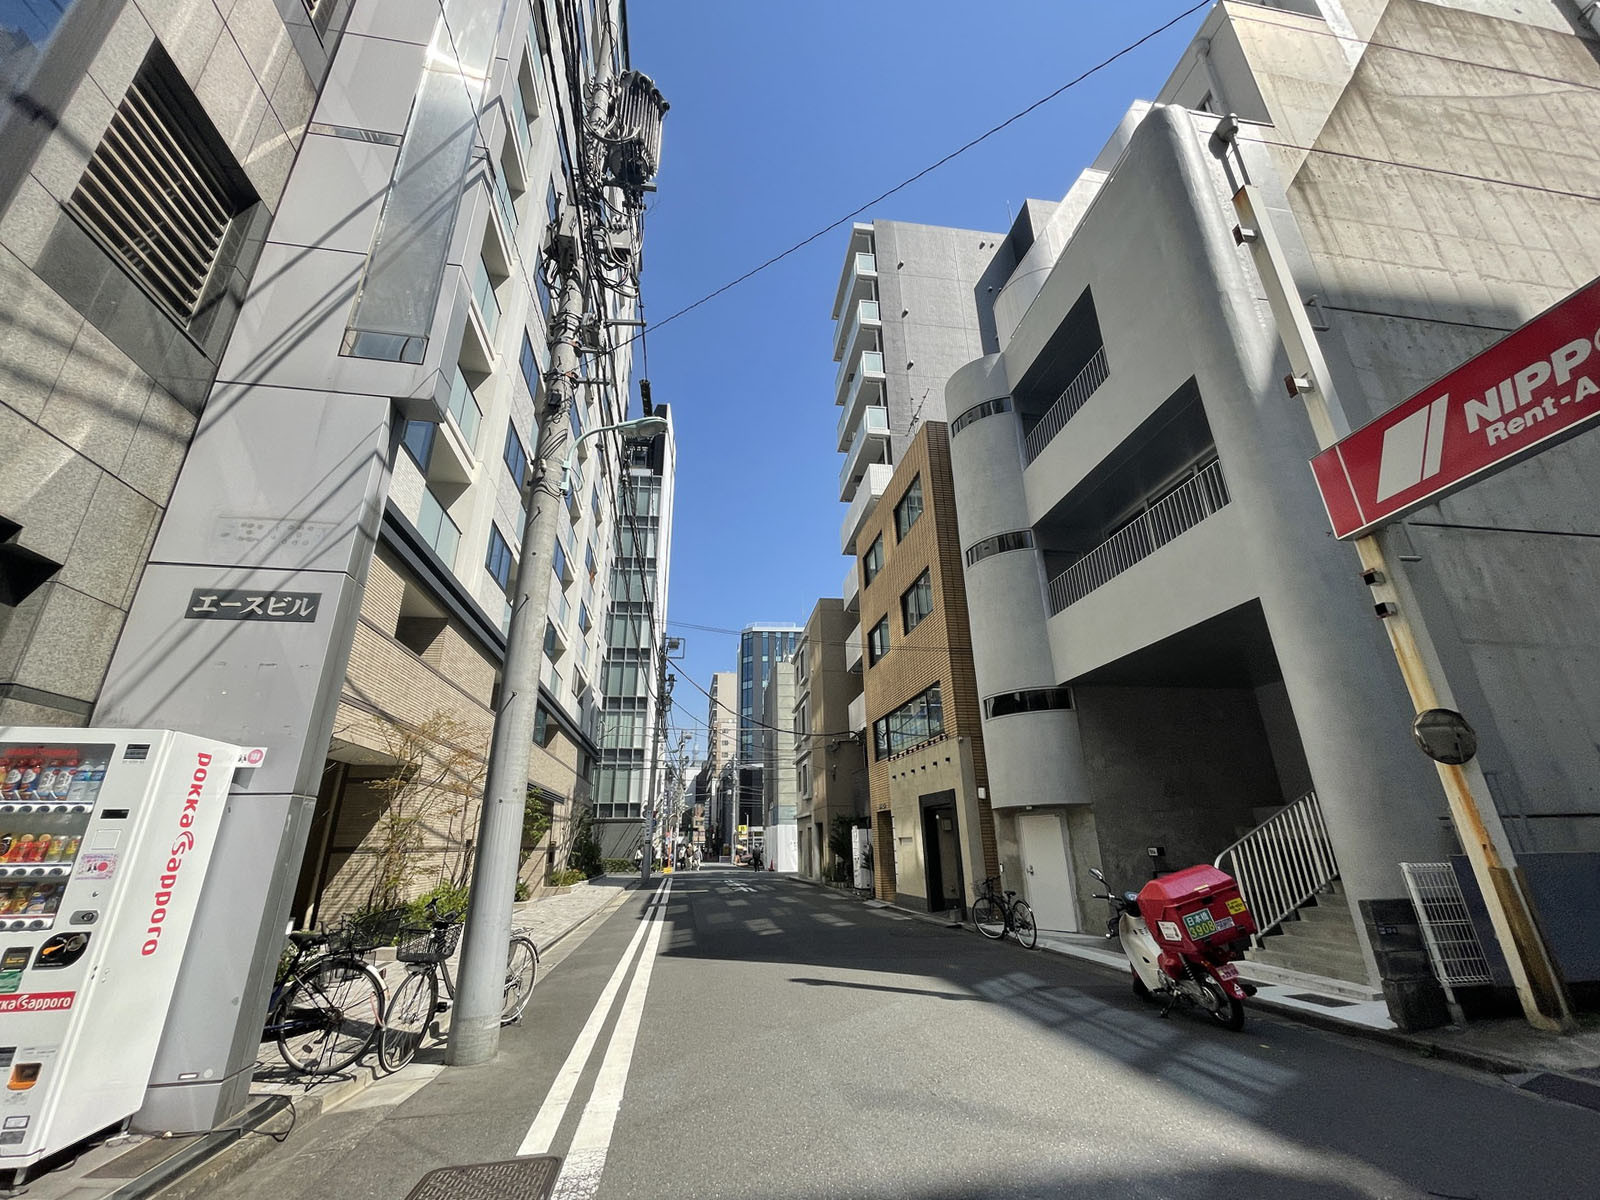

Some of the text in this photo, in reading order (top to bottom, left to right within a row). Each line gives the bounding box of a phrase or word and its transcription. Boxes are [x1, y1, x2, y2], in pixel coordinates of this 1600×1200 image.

[1464, 326, 1600, 433] NIPP
[192, 595, 314, 617] エースビル
[1189, 921, 1215, 938] 3908
